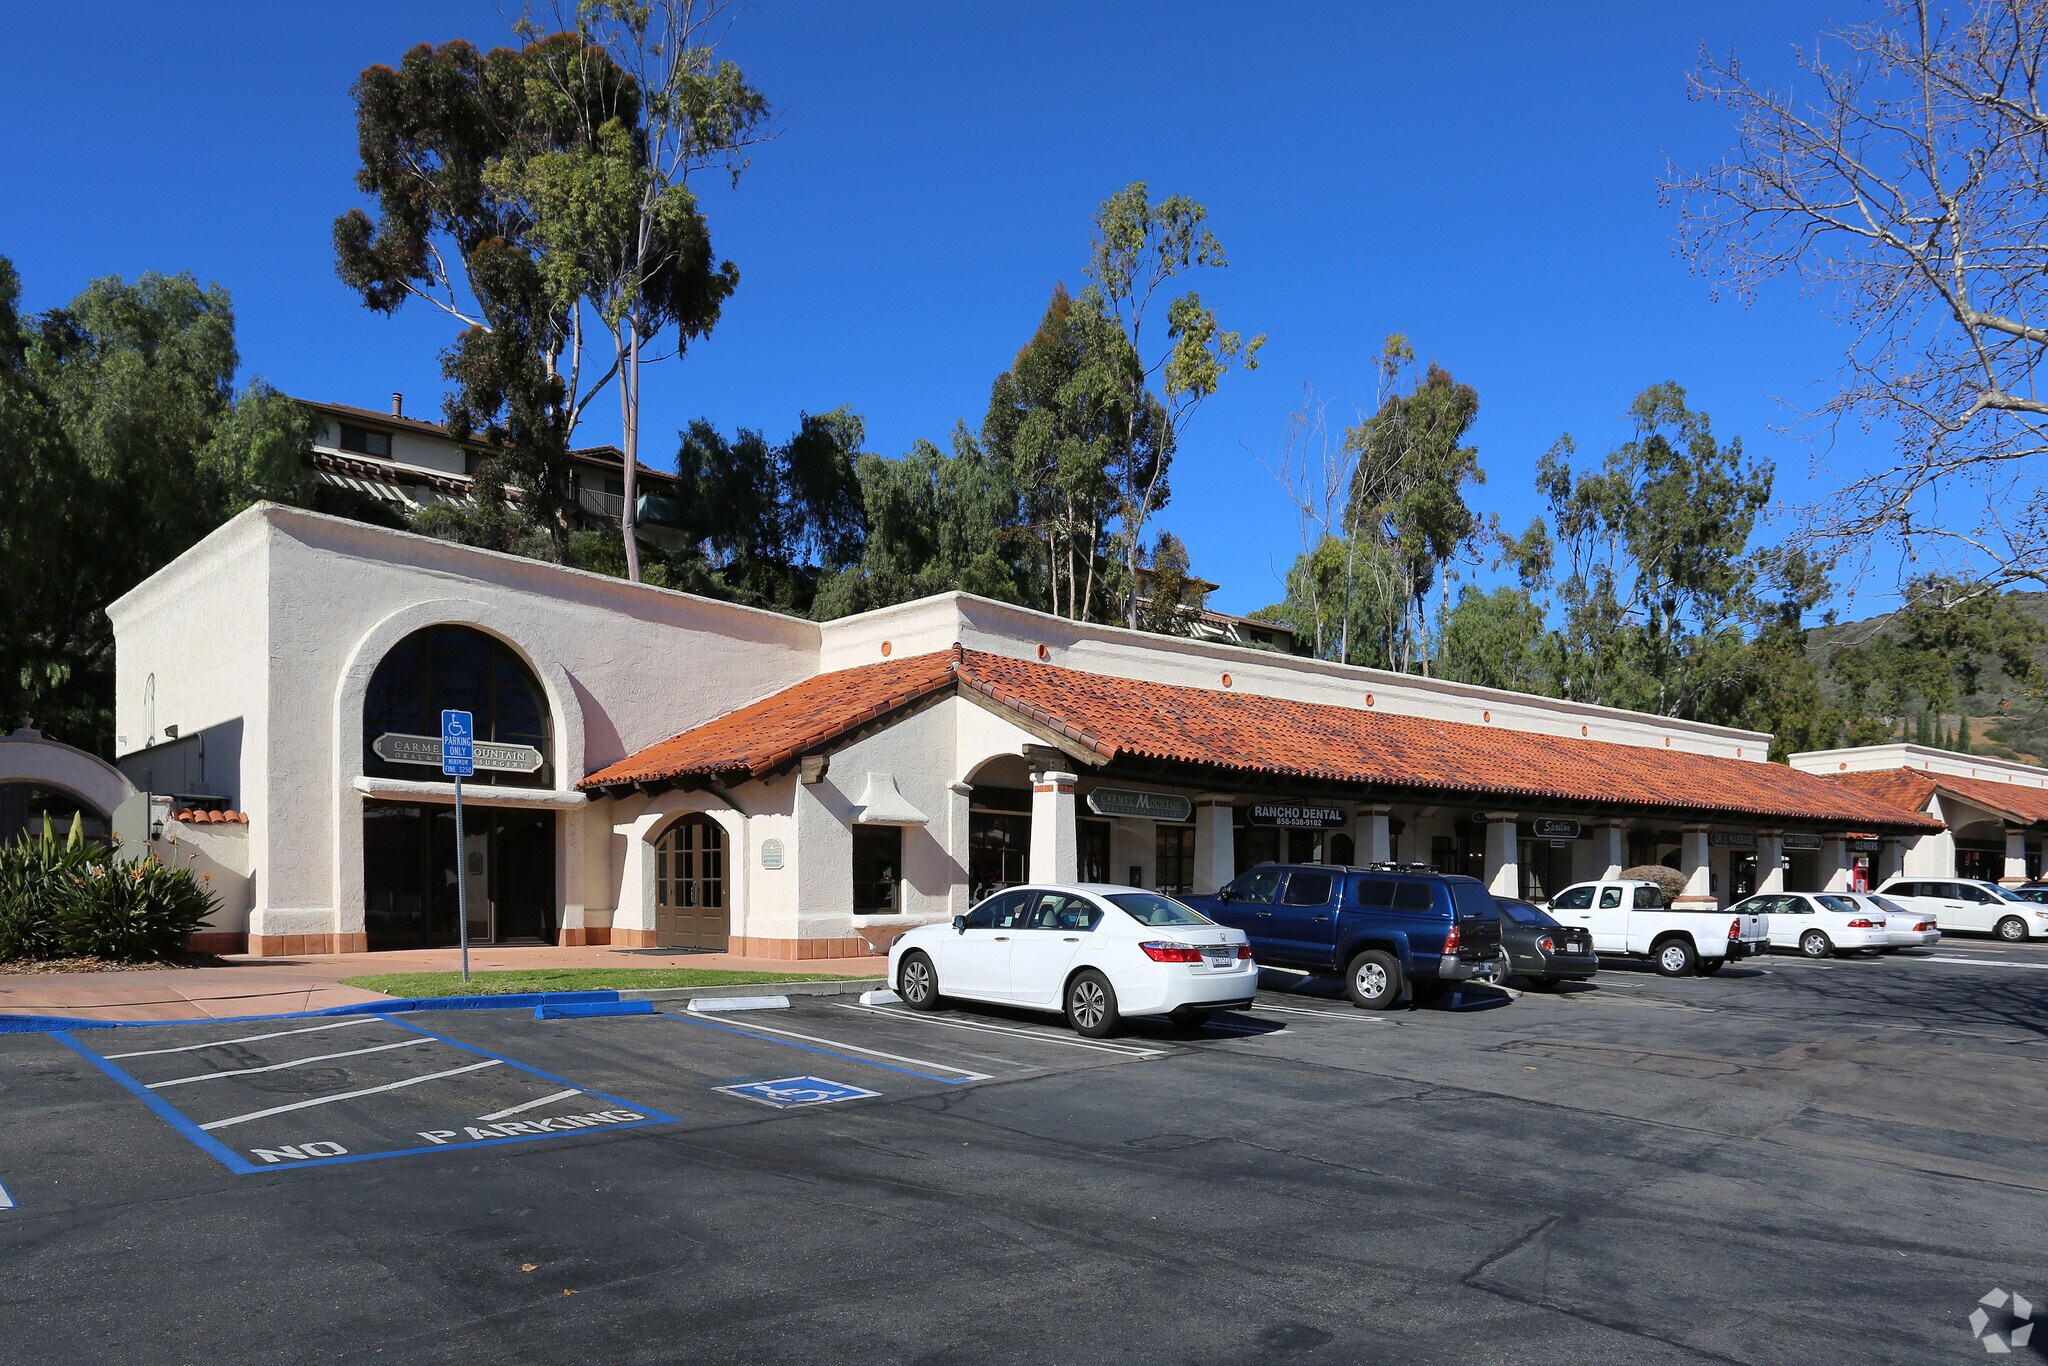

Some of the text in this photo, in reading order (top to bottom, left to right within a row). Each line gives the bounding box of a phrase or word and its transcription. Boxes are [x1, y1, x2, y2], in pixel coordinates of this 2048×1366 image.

[445, 736, 471, 747] PARKING
[393, 741, 526, 761] CARME OUNTAIN
[394, 752, 422, 761] ORAL
[449, 747, 467, 757] ONLY
[478, 759, 525, 769] SURGERY
[459, 766, 471, 774] $250
[1101, 794, 1182, 810] CARMEL MOUNTAIN
[1254, 805, 1342, 821] RANCHO DENTAL
[1276, 817, 1322, 827] 858-538-9182
[1714, 833, 1723, 843] DR
[1729, 834, 1755, 846] MASSAGE
[1855, 840, 1878, 851] CLEANERS
[250, 1109, 647, 1164] NO PARKING
